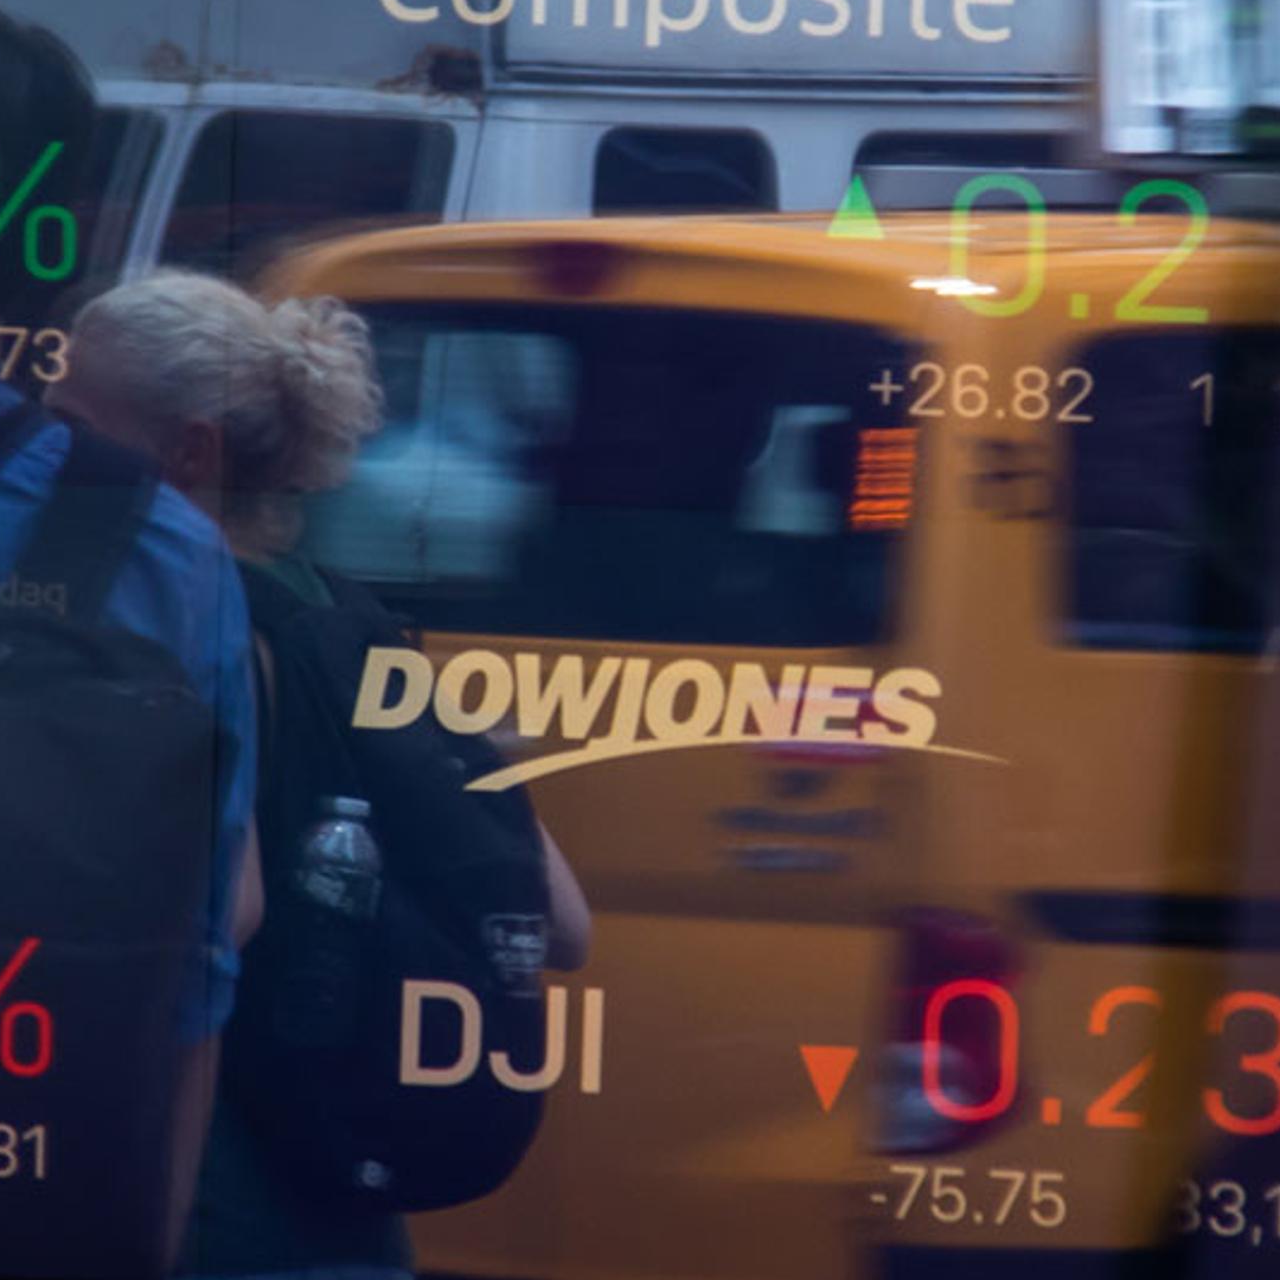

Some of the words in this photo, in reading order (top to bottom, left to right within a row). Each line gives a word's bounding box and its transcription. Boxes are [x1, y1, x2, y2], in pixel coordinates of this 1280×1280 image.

[869, 362, 1094, 423] +26.82
[399, 979, 604, 1094] DJI
[870, 1165, 1066, 1228] -75.75
